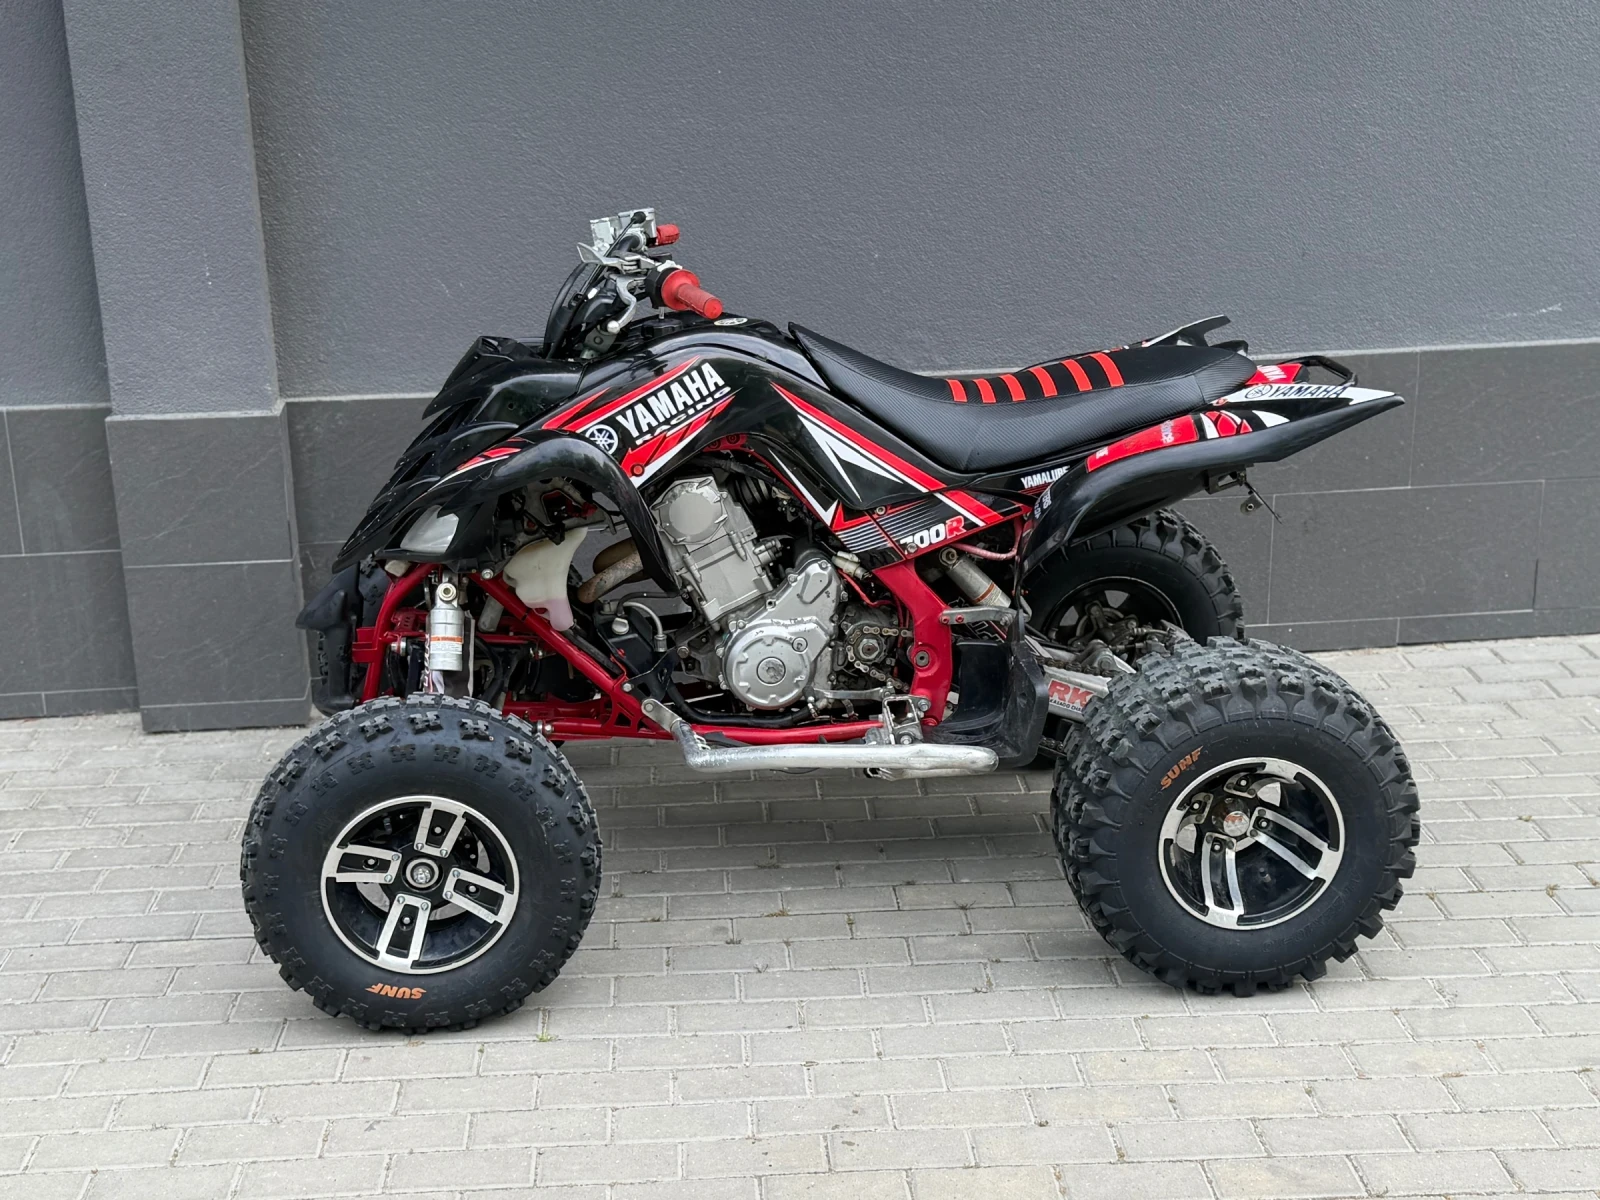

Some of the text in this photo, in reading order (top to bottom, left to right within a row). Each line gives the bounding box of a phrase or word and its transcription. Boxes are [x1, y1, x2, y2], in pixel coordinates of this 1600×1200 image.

[616, 362, 726, 439] YAMAHA
[1268, 385, 1349, 398] YAMAHA
[635, 386, 731, 446] RACING
[1048, 680, 1094, 707] RK
[1160, 746, 1203, 790] SUNF
[365, 983, 427, 999] SUNF
